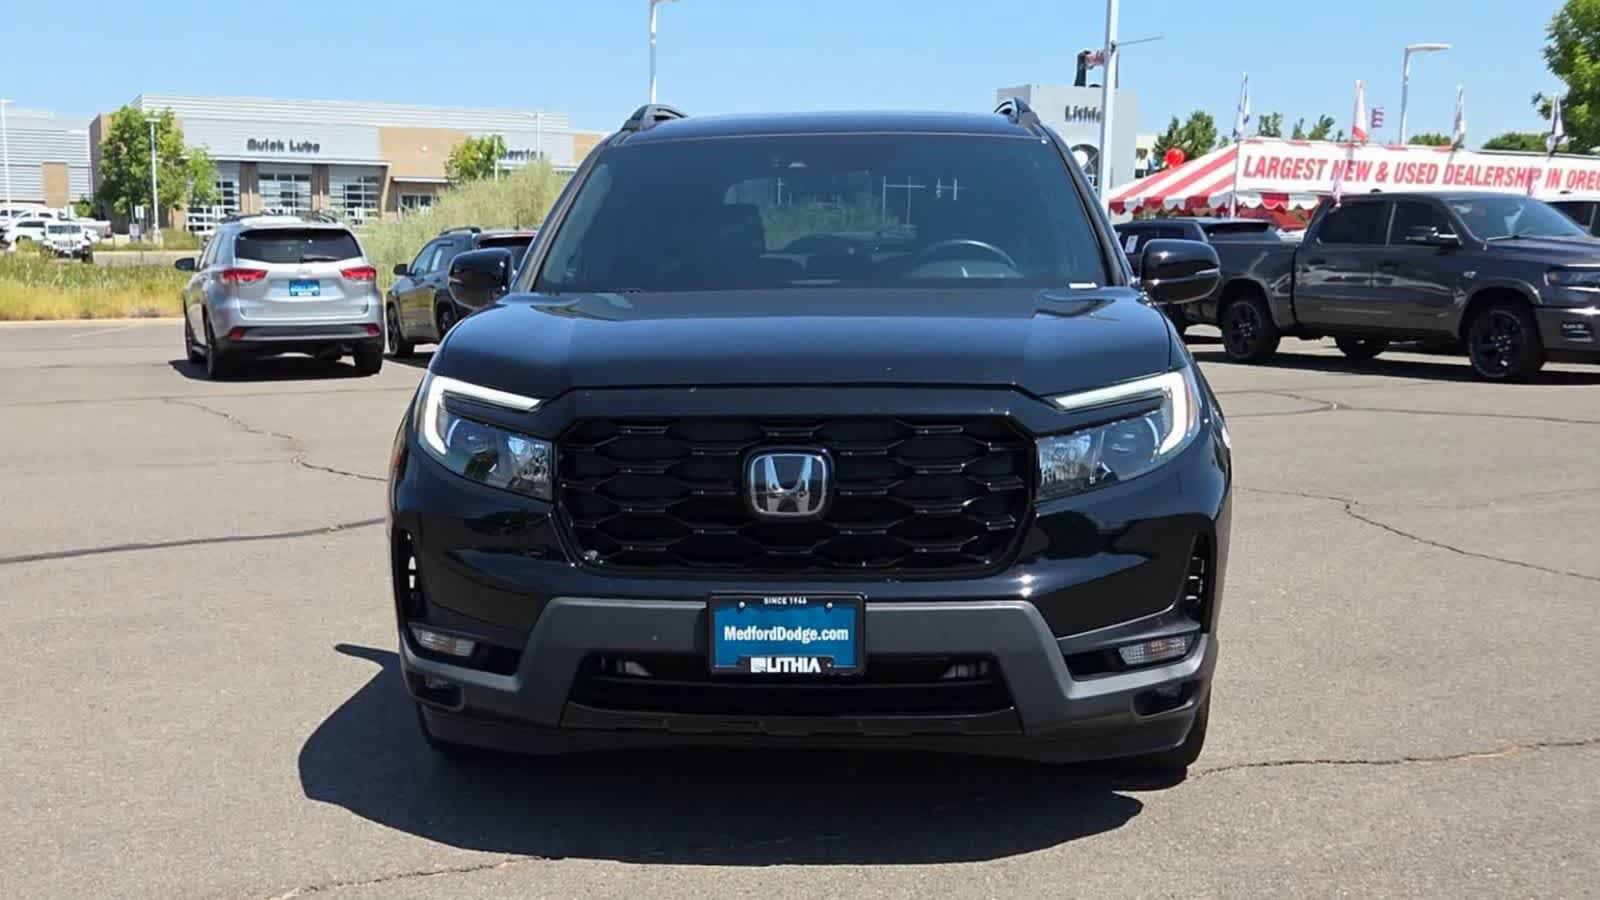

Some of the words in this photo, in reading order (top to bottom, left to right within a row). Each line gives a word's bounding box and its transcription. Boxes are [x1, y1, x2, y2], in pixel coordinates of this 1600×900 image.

[1243, 155, 1328, 181] LARGEST
[1330, 159, 1373, 182] NEW
[1375, 161, 1388, 183] &
[1394, 162, 1438, 185] USED
[1442, 162, 1542, 189] DEALERSHIP
[1545, 167, 1563, 189] IN
[764, 596, 788, 605] SINCE
[724, 626, 849, 644] MedfordDodge.com
[766, 657, 821, 673] LITHIA
